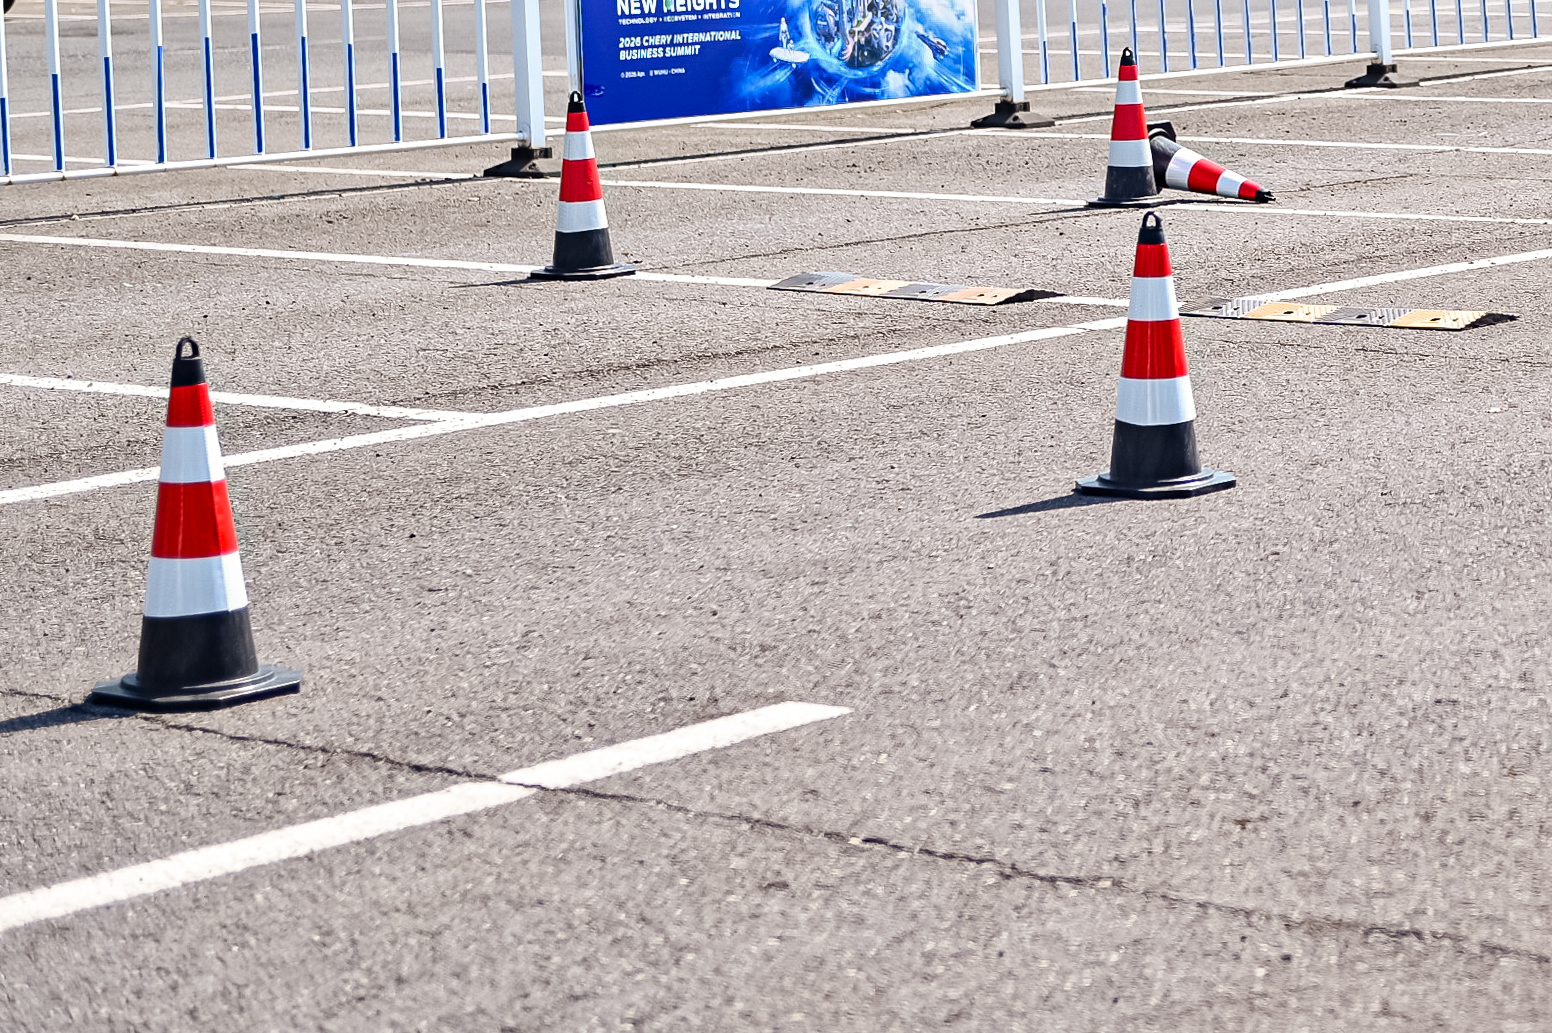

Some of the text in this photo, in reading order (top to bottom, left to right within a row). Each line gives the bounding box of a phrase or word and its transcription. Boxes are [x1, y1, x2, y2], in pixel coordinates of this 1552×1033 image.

[618, 16, 658, 26] TECHNOLOGY
[663, 14, 698, 23] ECOSYSTEM
[619, 29, 741, 48] 2026 CHERY INTERNATIONAL
[619, 44, 701, 61] BUSINESS SUMMIT
